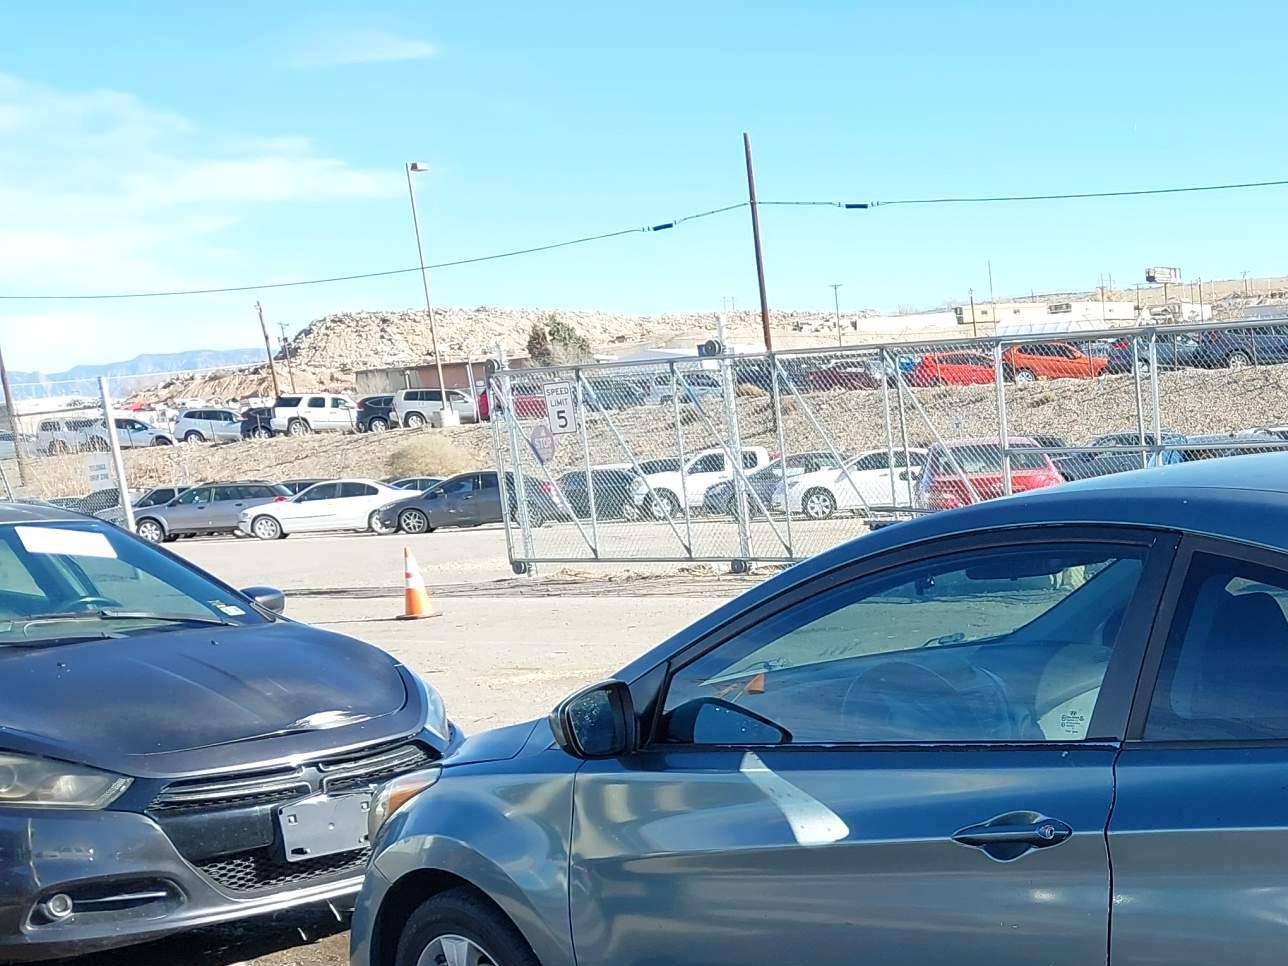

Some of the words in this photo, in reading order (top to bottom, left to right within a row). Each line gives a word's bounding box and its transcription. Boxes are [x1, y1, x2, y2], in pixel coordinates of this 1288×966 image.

[546, 387, 569, 396] SPEED
[550, 398, 568, 407] LIMIT
[556, 409, 568, 428] 5
